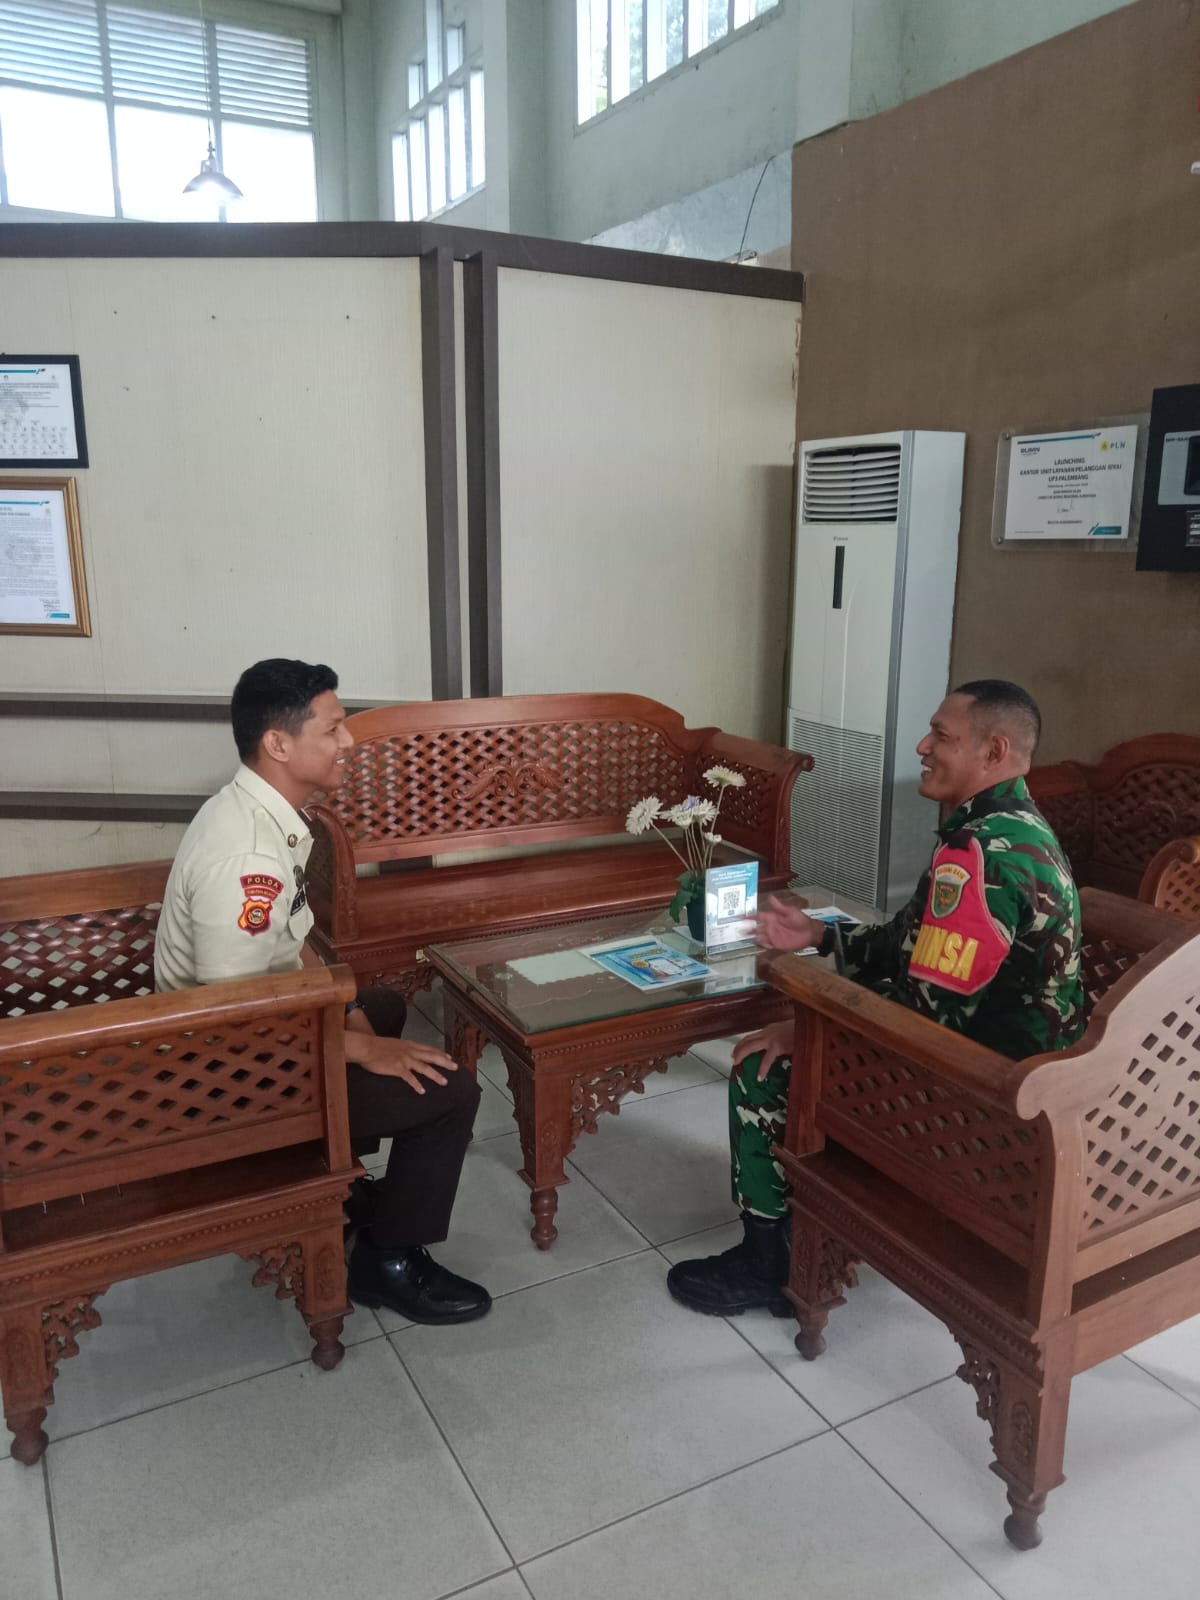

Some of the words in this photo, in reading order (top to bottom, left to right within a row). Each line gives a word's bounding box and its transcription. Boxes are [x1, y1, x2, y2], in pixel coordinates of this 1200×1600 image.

[1110, 441, 1126, 449] PLN
[1054, 457, 1086, 465] LAUNCHING
[1075, 465, 1106, 473] PELANGGAN
[1058, 474, 1089, 482] PALEMBANG
[247, 877, 279, 889] POLDA
[910, 924, 979, 982] INSA
